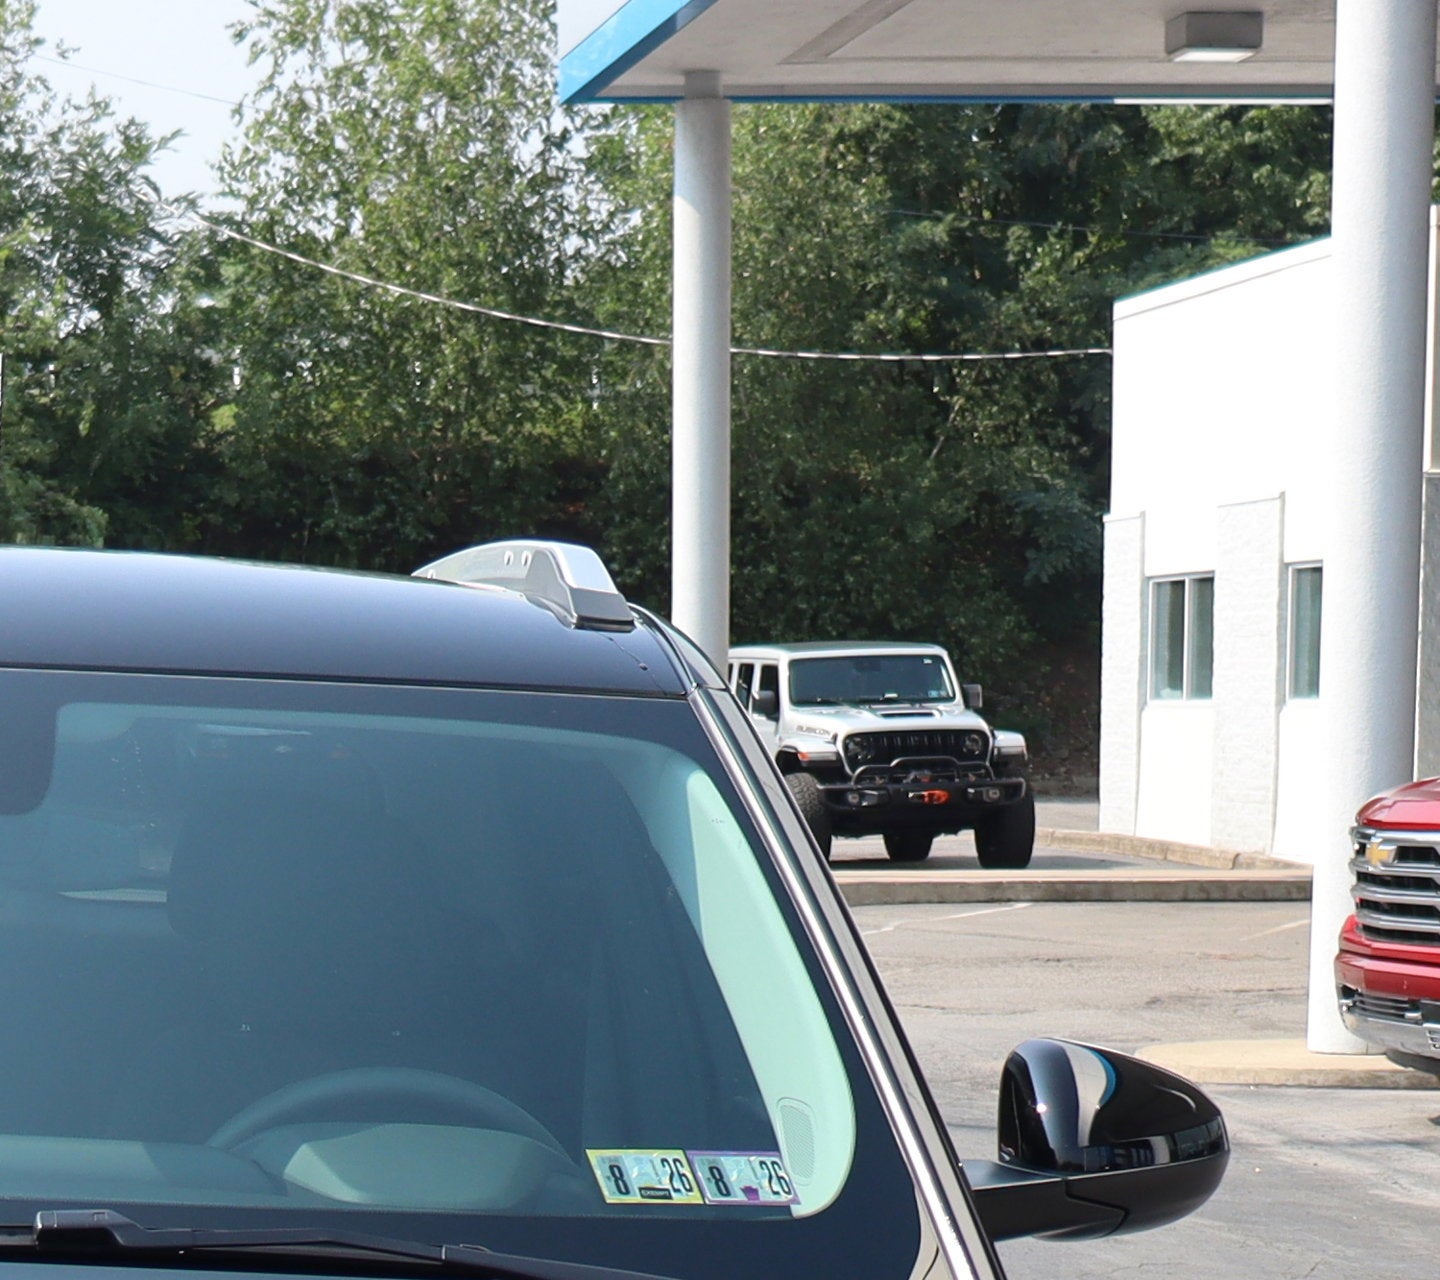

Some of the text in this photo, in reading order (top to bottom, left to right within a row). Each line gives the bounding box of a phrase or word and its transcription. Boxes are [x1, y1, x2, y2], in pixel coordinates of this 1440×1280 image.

[609, 1164, 631, 1195] 8
[660, 1157, 693, 1193] 26
[708, 1166, 731, 1196] 8
[759, 1160, 792, 1195] 26
